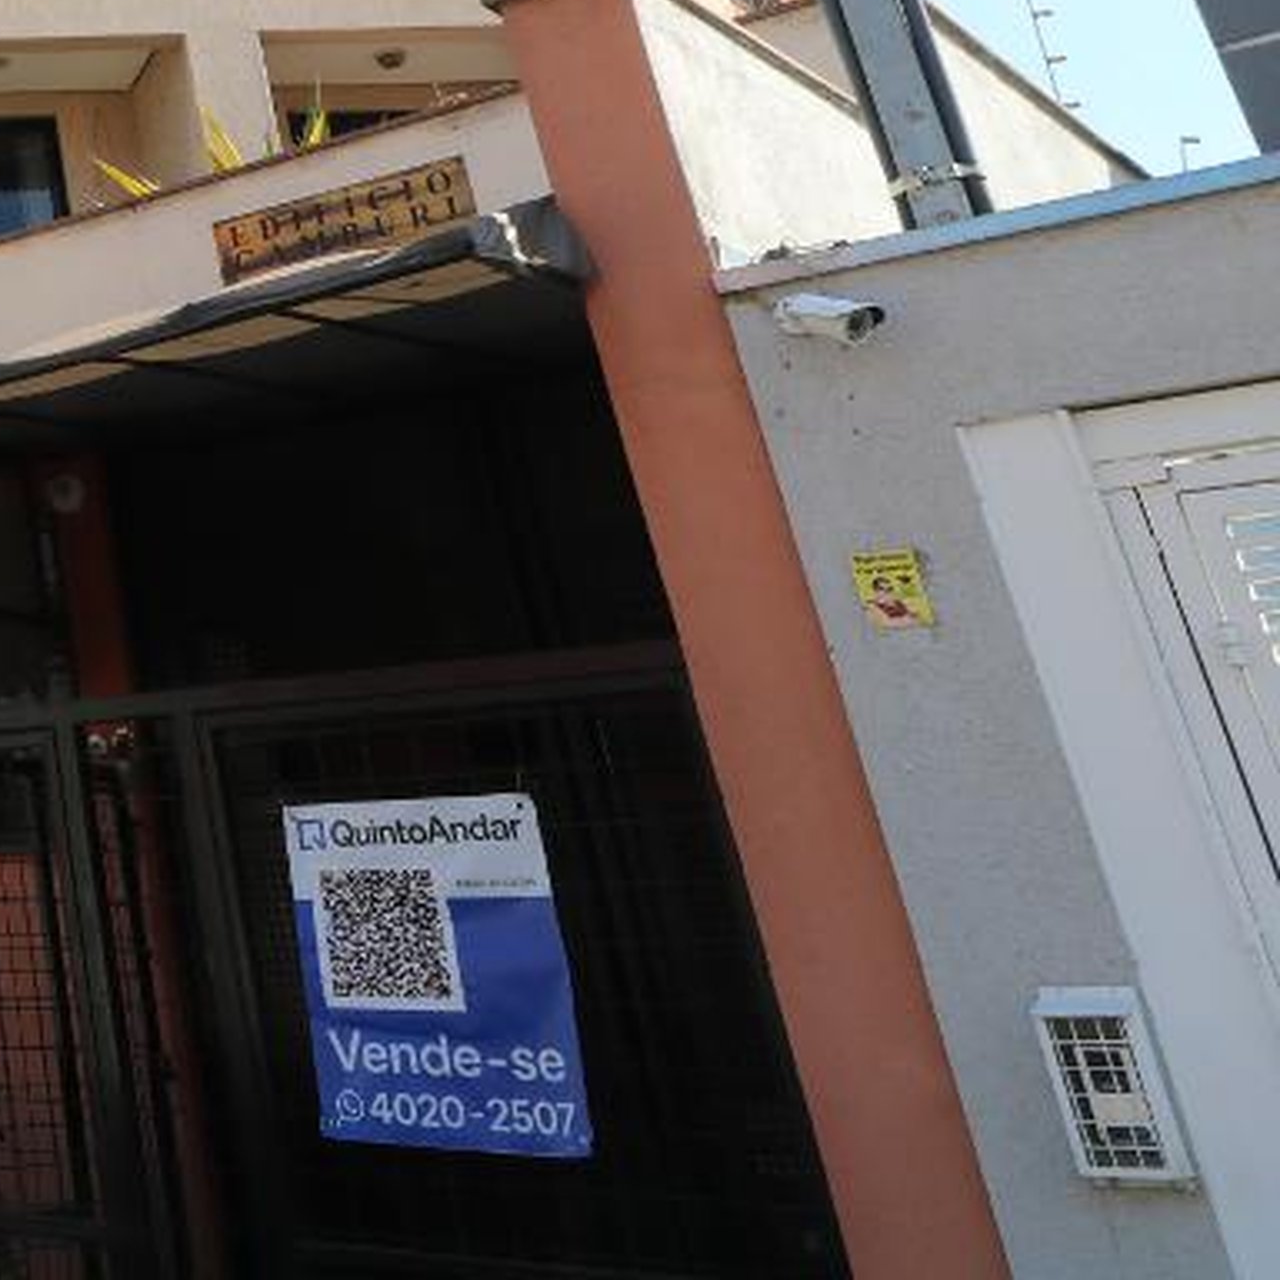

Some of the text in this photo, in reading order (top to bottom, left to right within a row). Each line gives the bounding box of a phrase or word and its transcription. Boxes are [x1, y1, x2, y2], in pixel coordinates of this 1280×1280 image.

[229, 168, 452, 248] EDIFICIO
[329, 813, 522, 849] QuintoAndar
[327, 1028, 566, 1082] Vende-se
[369, 1090, 576, 1137] 4020-2507
